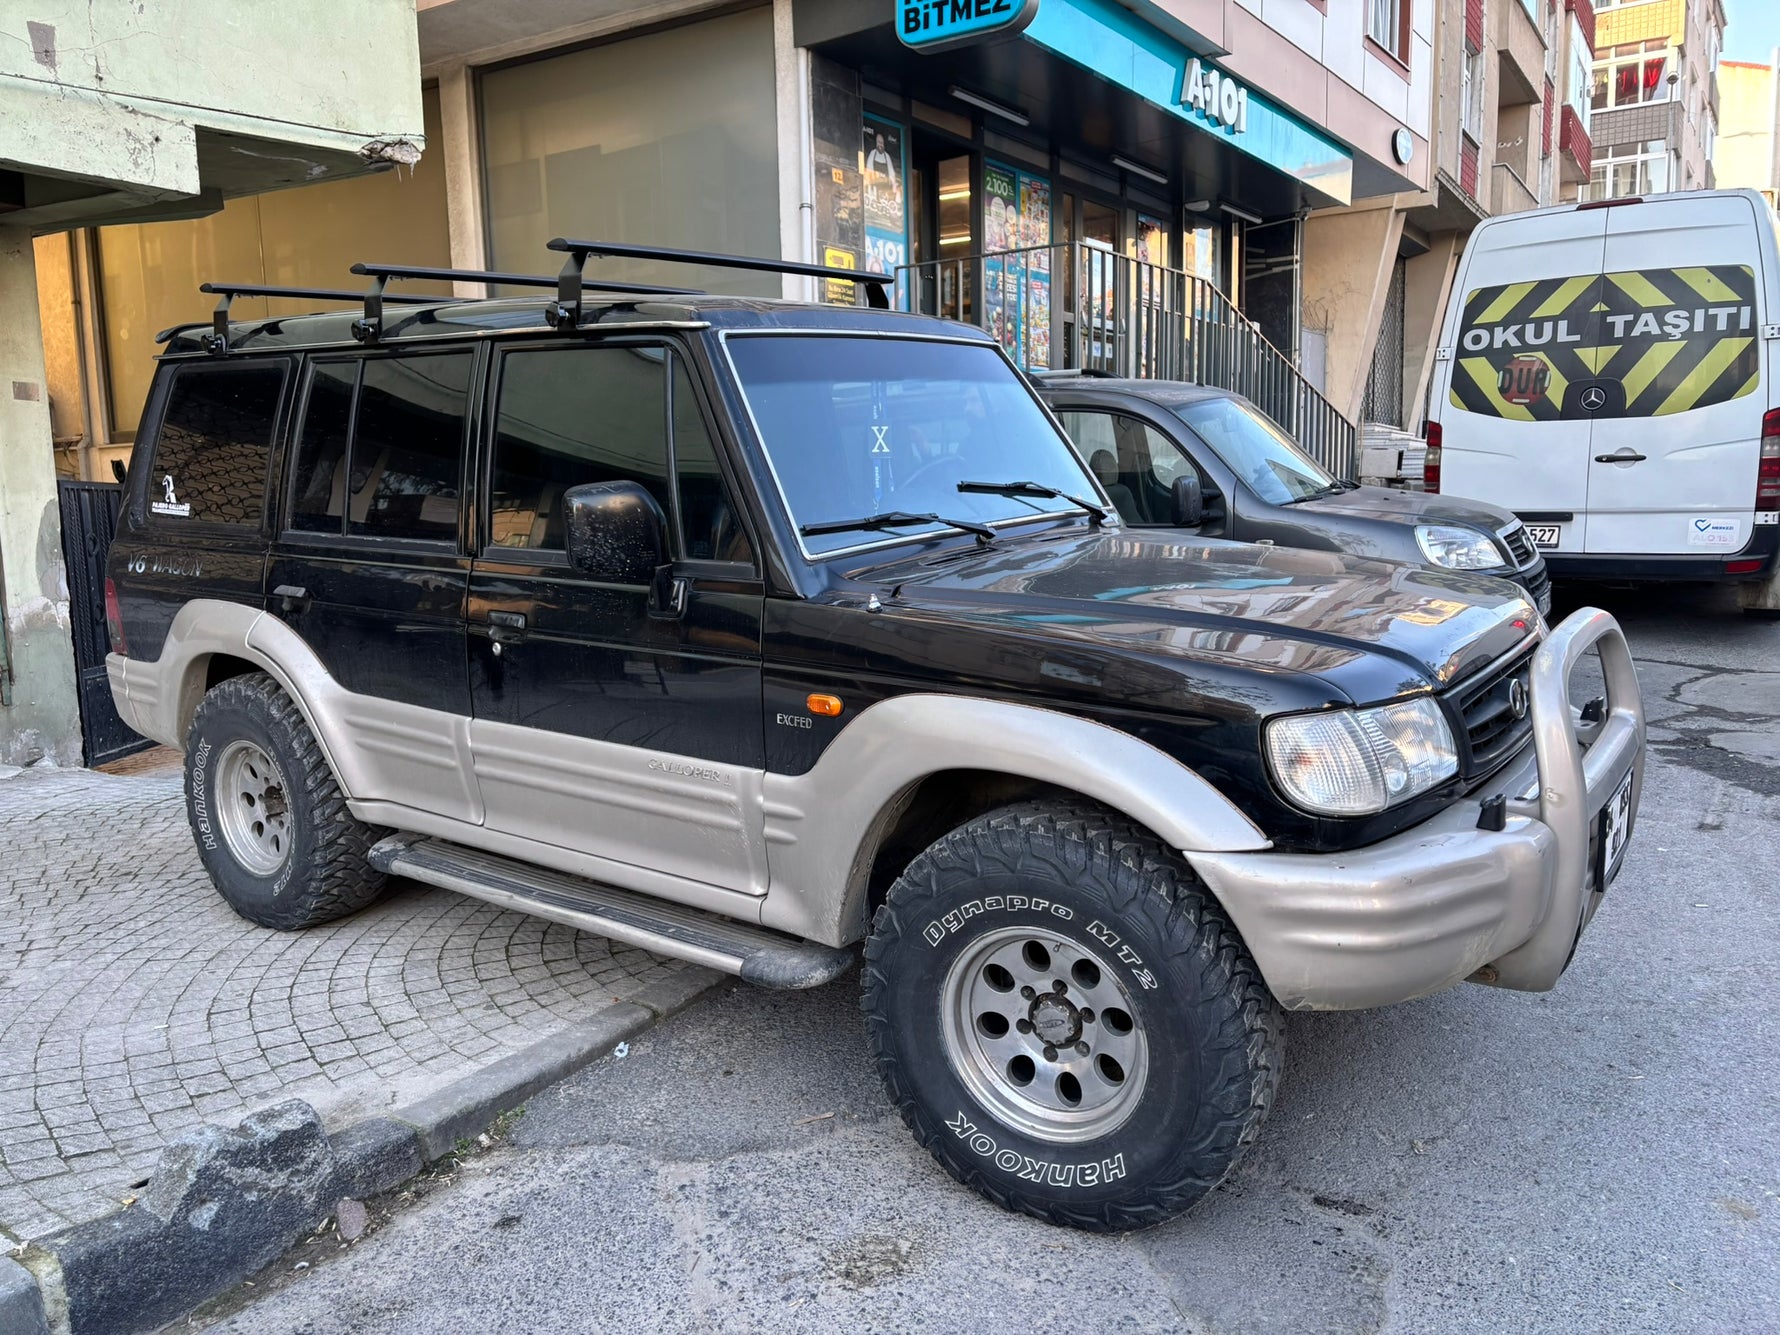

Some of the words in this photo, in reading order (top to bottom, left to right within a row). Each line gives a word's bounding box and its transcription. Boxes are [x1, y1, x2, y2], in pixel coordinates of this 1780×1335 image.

[1463, 319, 1581, 350] OKUL
[1606, 306, 1751, 339] TAŞITI
[1500, 367, 1547, 395] DUR
[871, 426, 890, 453] X
[1530, 528, 1556, 543] 527
[128, 551, 148, 573] V6
[153, 554, 204, 577] WAGON
[648, 758, 721, 783] GALLOPER
[922, 895, 1073, 947] Dynapro
[1086, 920, 1158, 990] MT2
